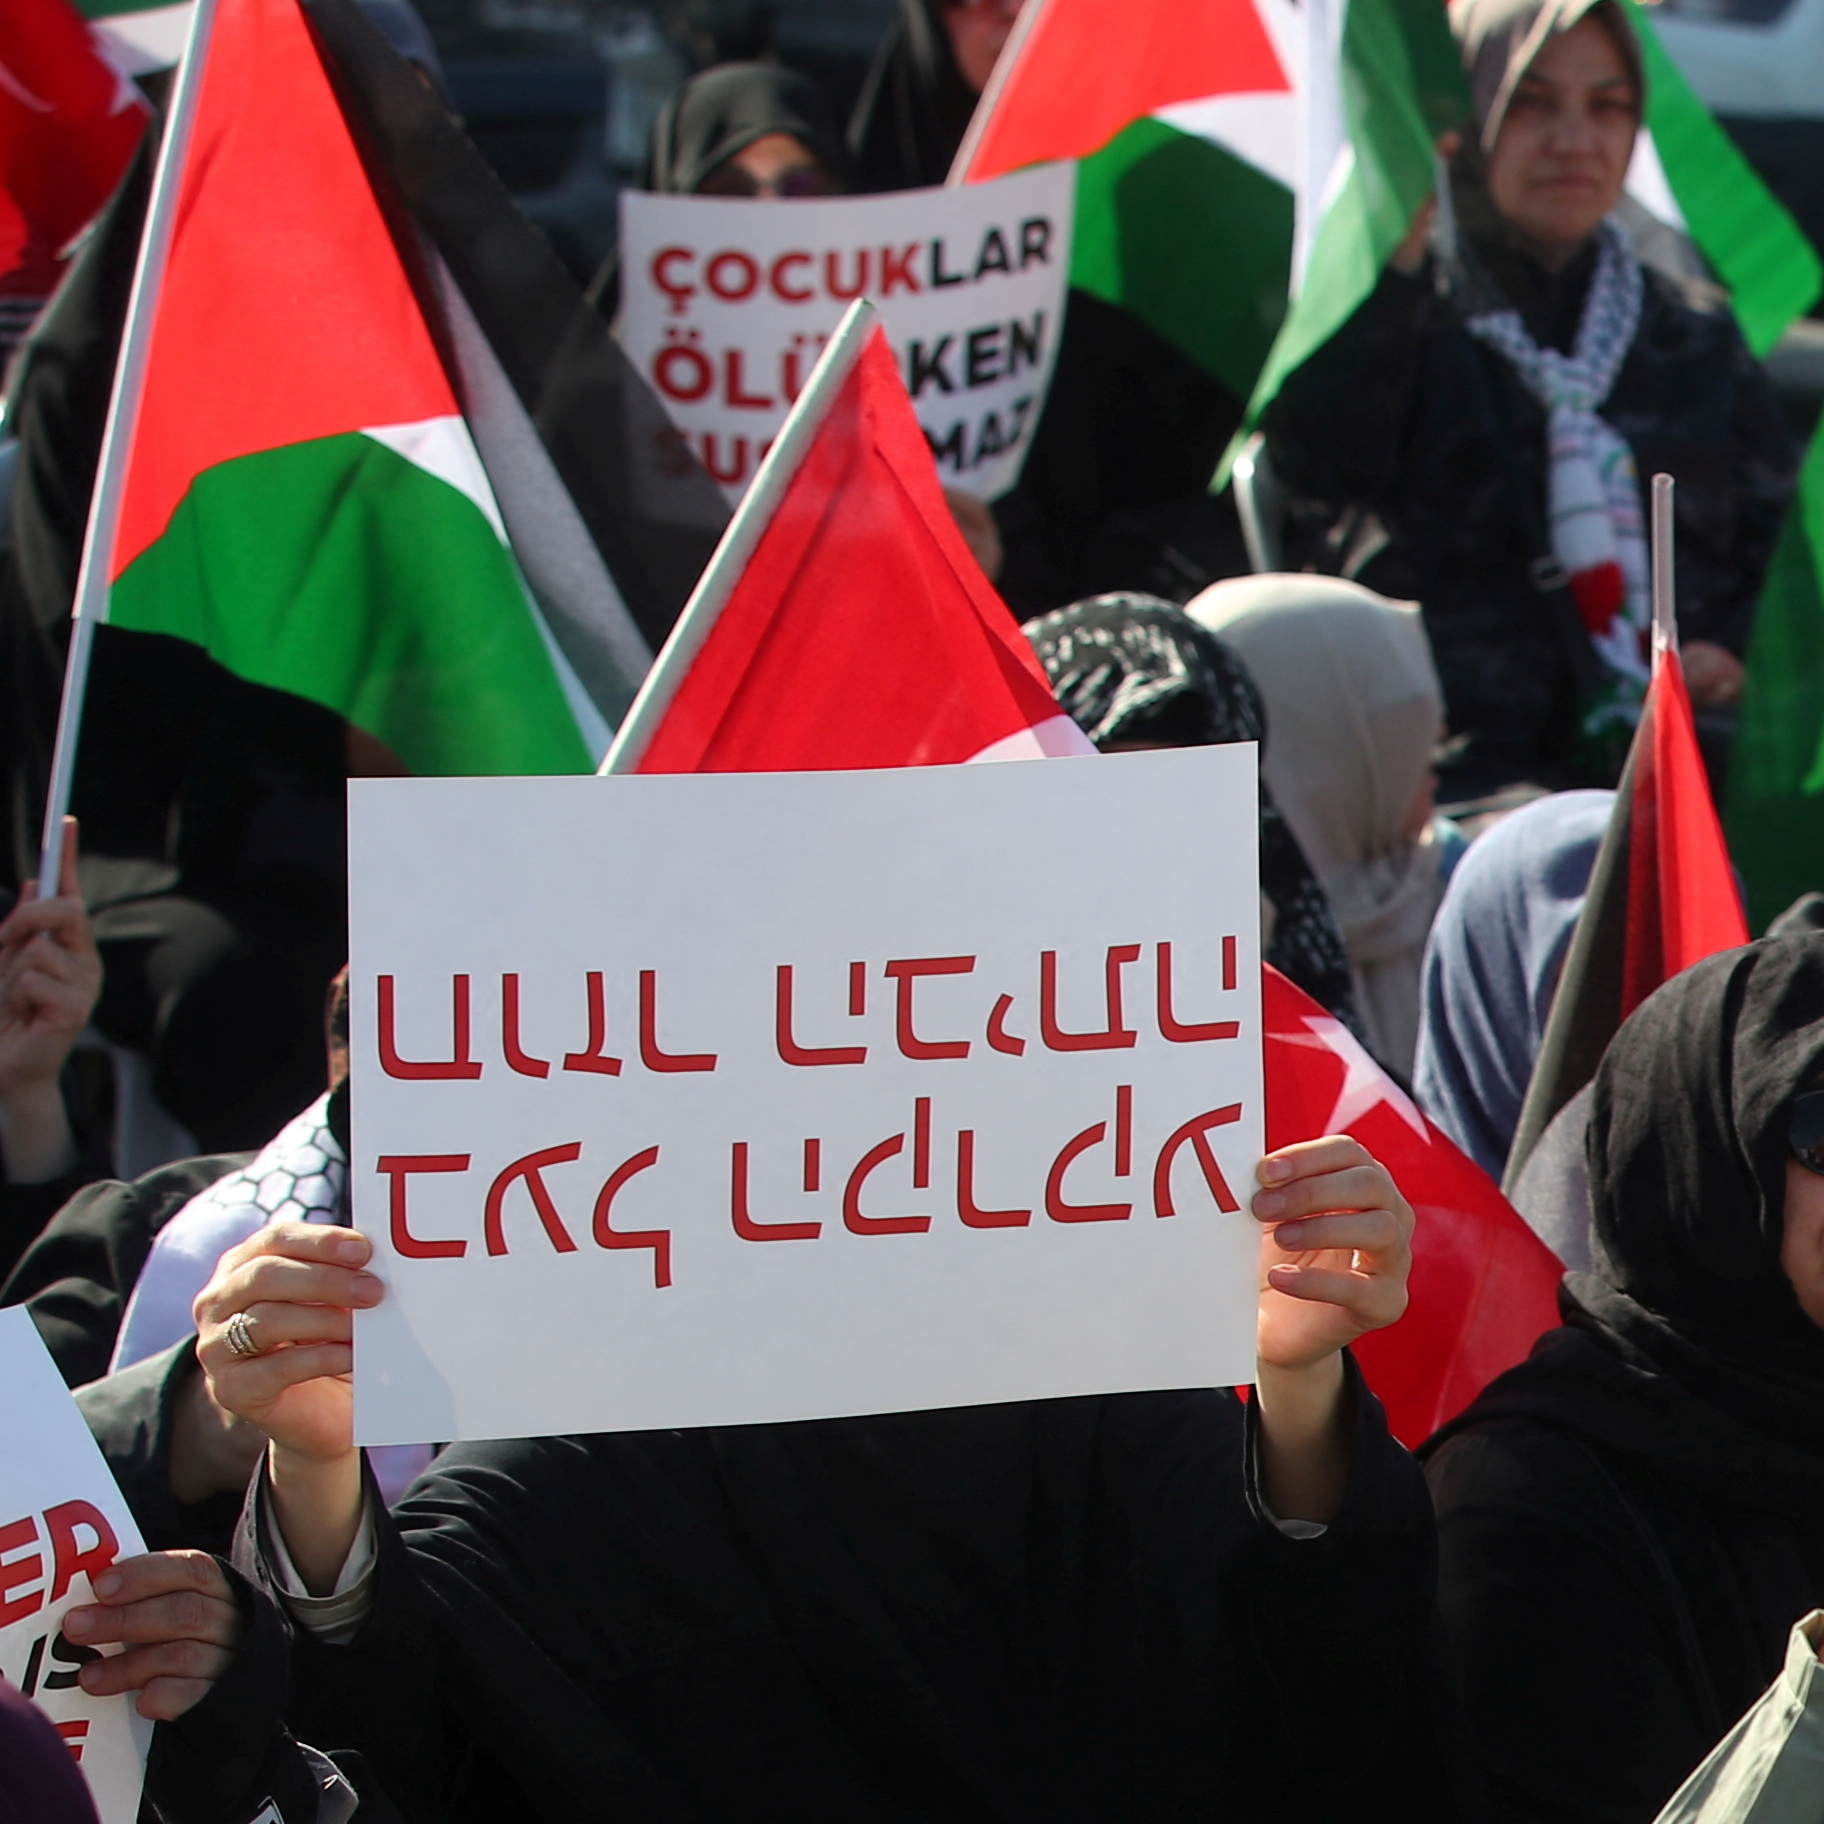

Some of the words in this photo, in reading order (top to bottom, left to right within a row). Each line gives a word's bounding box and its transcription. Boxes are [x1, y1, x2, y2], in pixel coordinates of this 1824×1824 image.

[650, 218, 1051, 312] ÇOCUKLAR
[653, 310, 1046, 408] ÖLÜKEN
[378, 970, 717, 1080] חוזר
[776, 936, 1239, 1066] הביתה
[376, 1142, 671, 1288] בעל
[732, 1085, 1242, 1241] הקרקע
